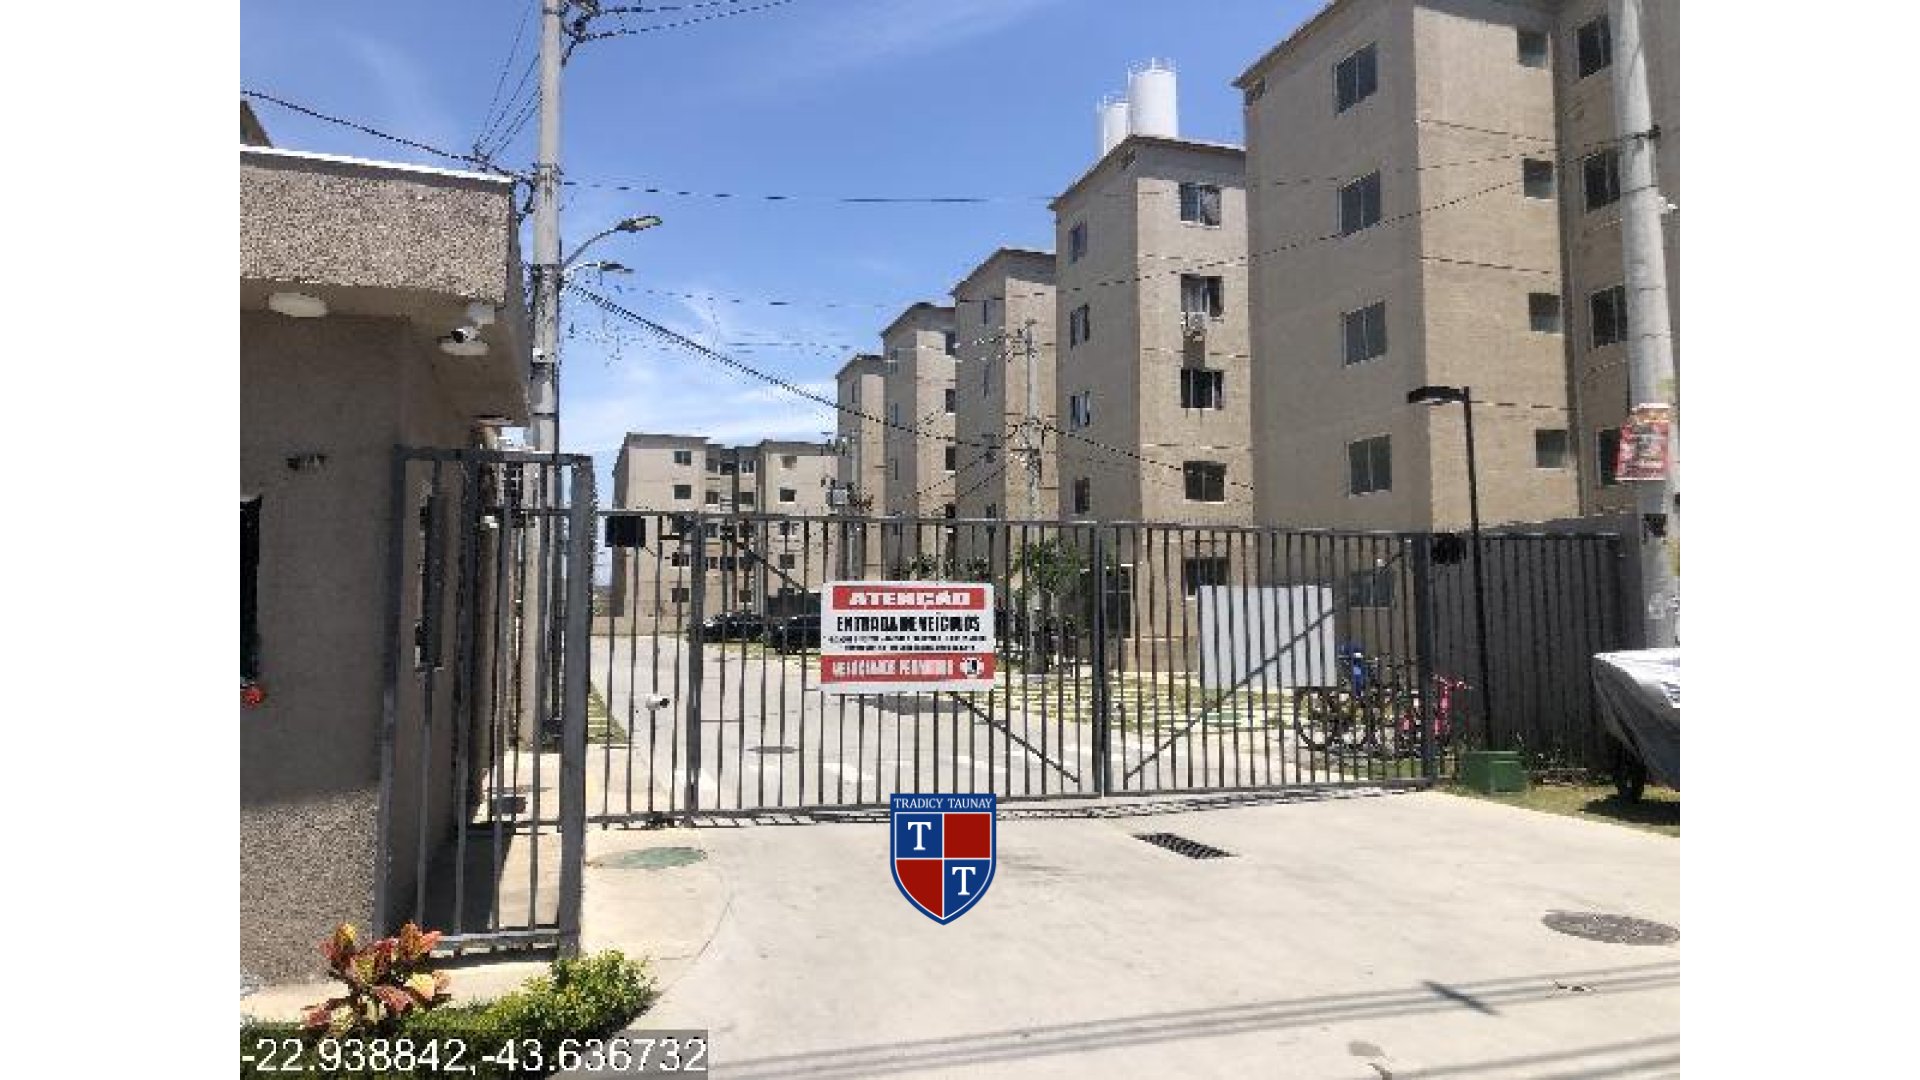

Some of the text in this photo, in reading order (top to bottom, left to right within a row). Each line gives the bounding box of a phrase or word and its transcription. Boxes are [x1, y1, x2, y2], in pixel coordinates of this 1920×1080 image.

[849, 591, 971, 610] ATENÇÃO
[837, 614, 899, 632] ENTRADA
[899, 616, 918, 632] DE
